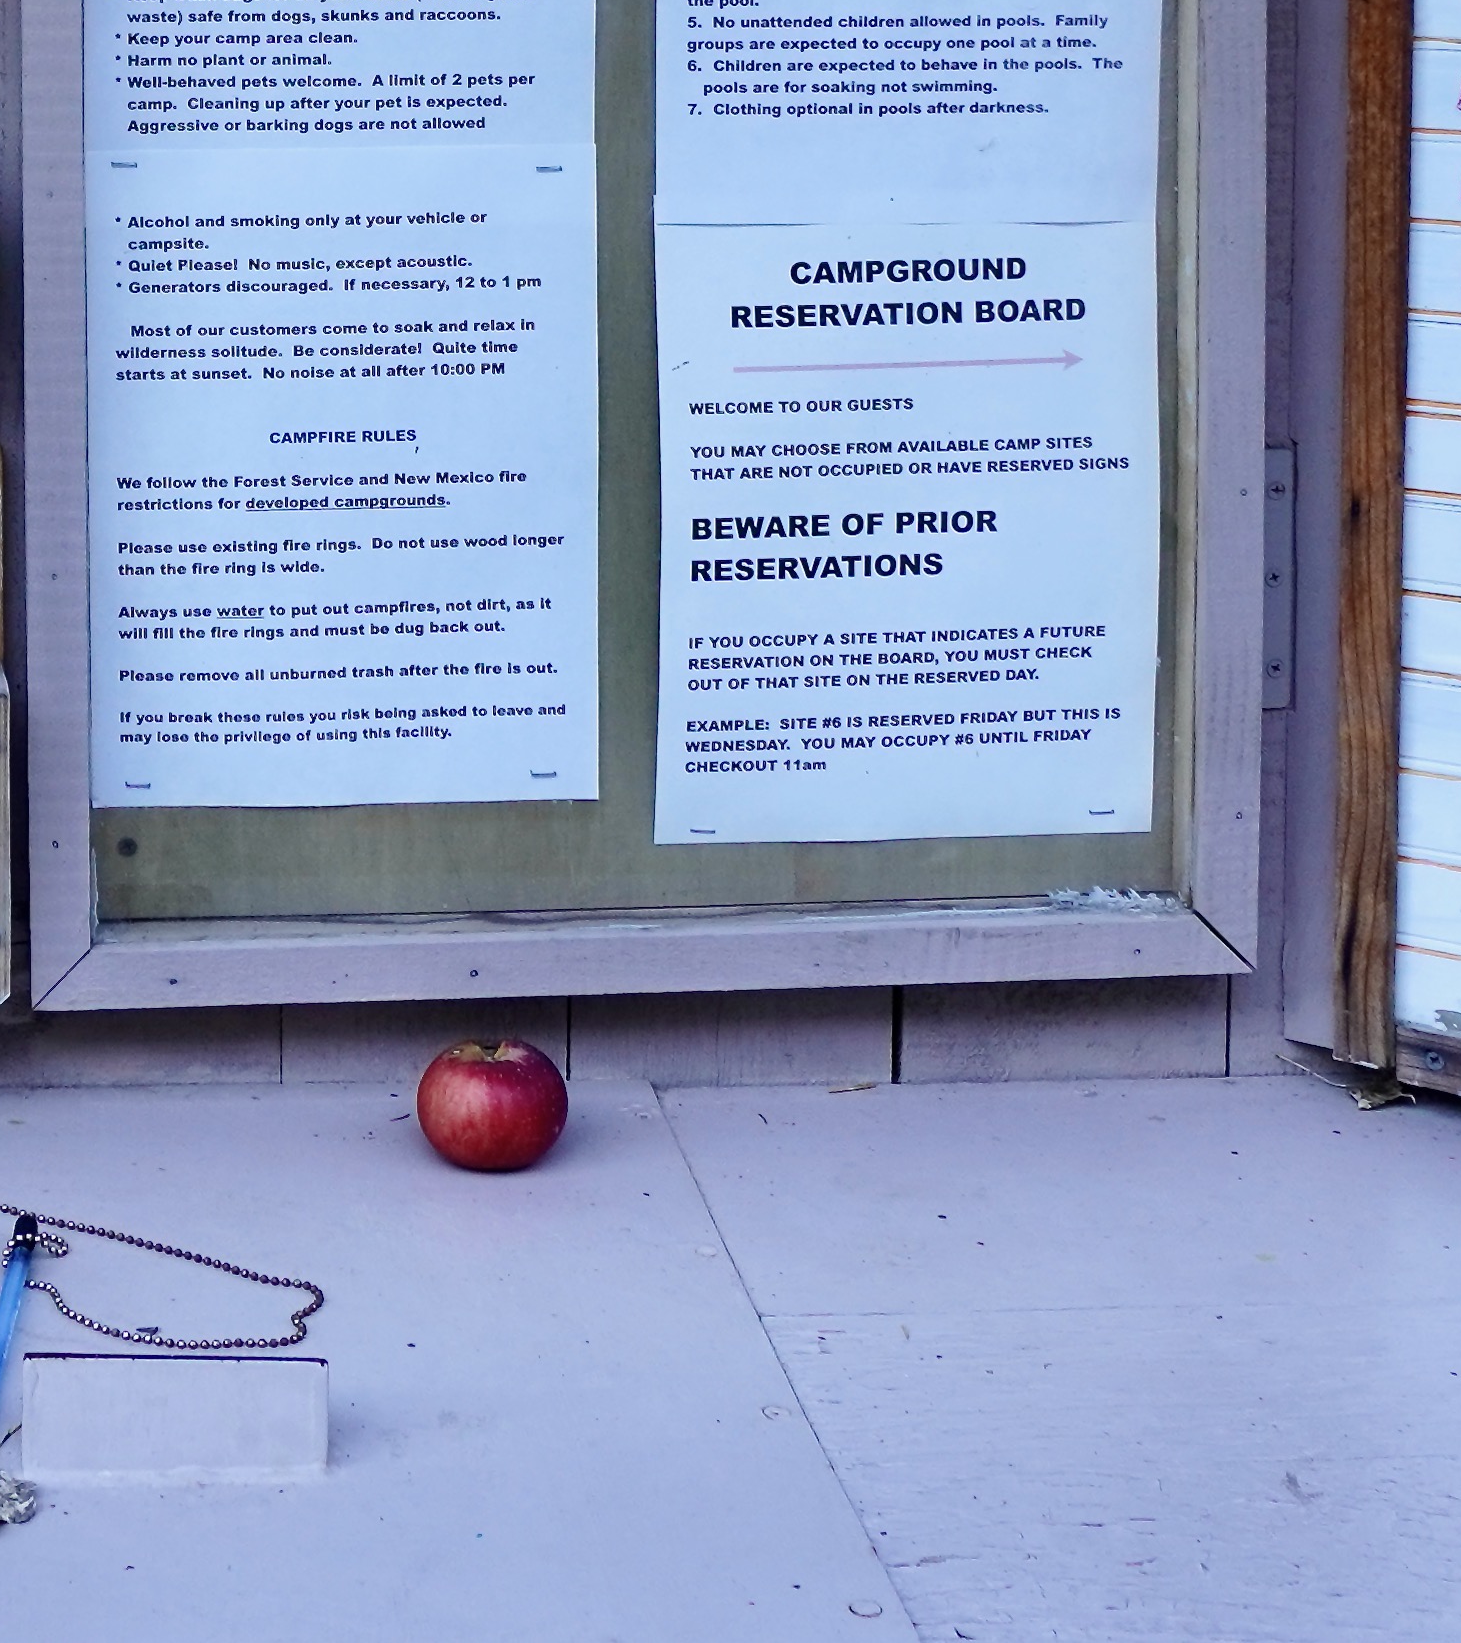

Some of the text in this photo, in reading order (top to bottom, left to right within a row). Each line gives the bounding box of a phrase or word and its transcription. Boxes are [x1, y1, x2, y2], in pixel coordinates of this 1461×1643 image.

[789, 256, 1028, 286] CAMPGROUND
[730, 297, 1087, 330] RESERVATION BOARD
[269, 429, 417, 444] CAMPFIRE RULES
[690, 509, 999, 542] BEWARE OF PRIOR
[690, 551, 944, 583] RESERVATIONS
[685, 759, 827, 773] CHECKOUT 11am
